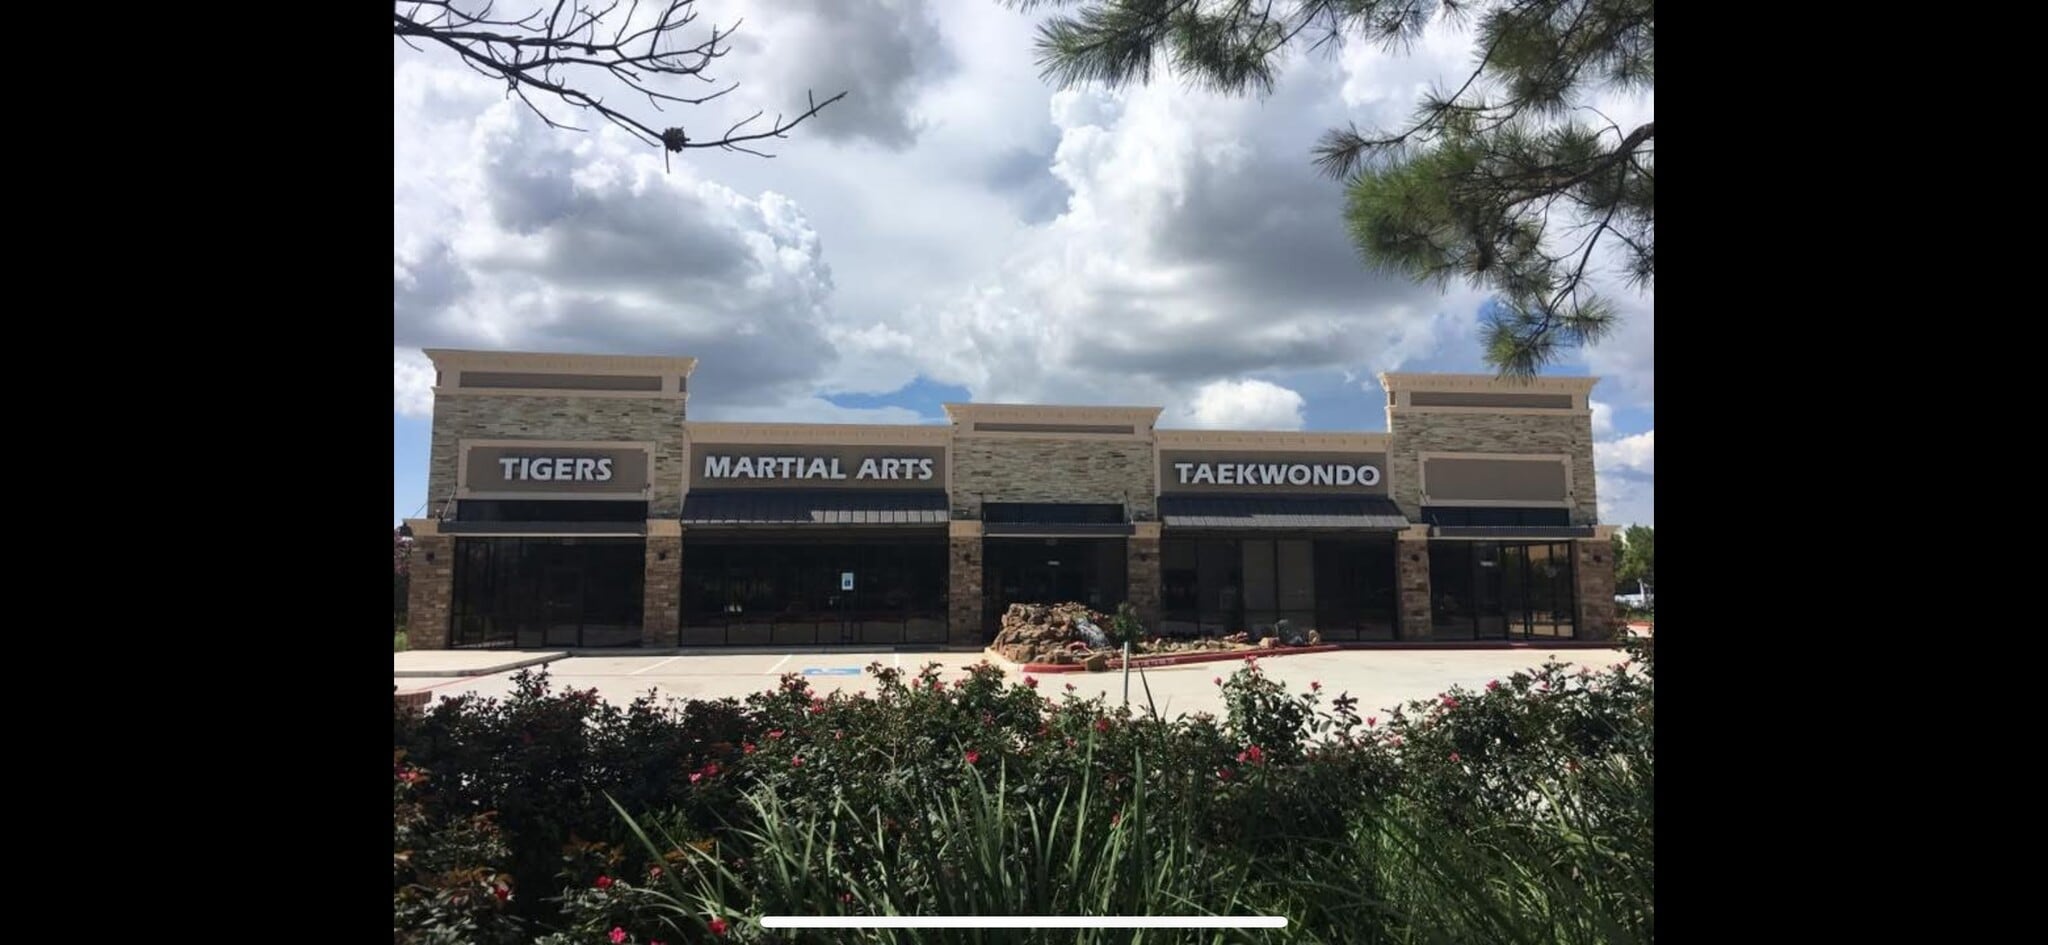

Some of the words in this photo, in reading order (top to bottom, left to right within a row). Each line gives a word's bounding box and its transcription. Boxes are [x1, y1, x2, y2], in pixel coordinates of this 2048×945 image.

[499, 457, 612, 480] TIGERS
[704, 456, 847, 479] MARTIAL
[856, 458, 934, 480] ARTS
[1175, 463, 1380, 486] TAEKWONDO
